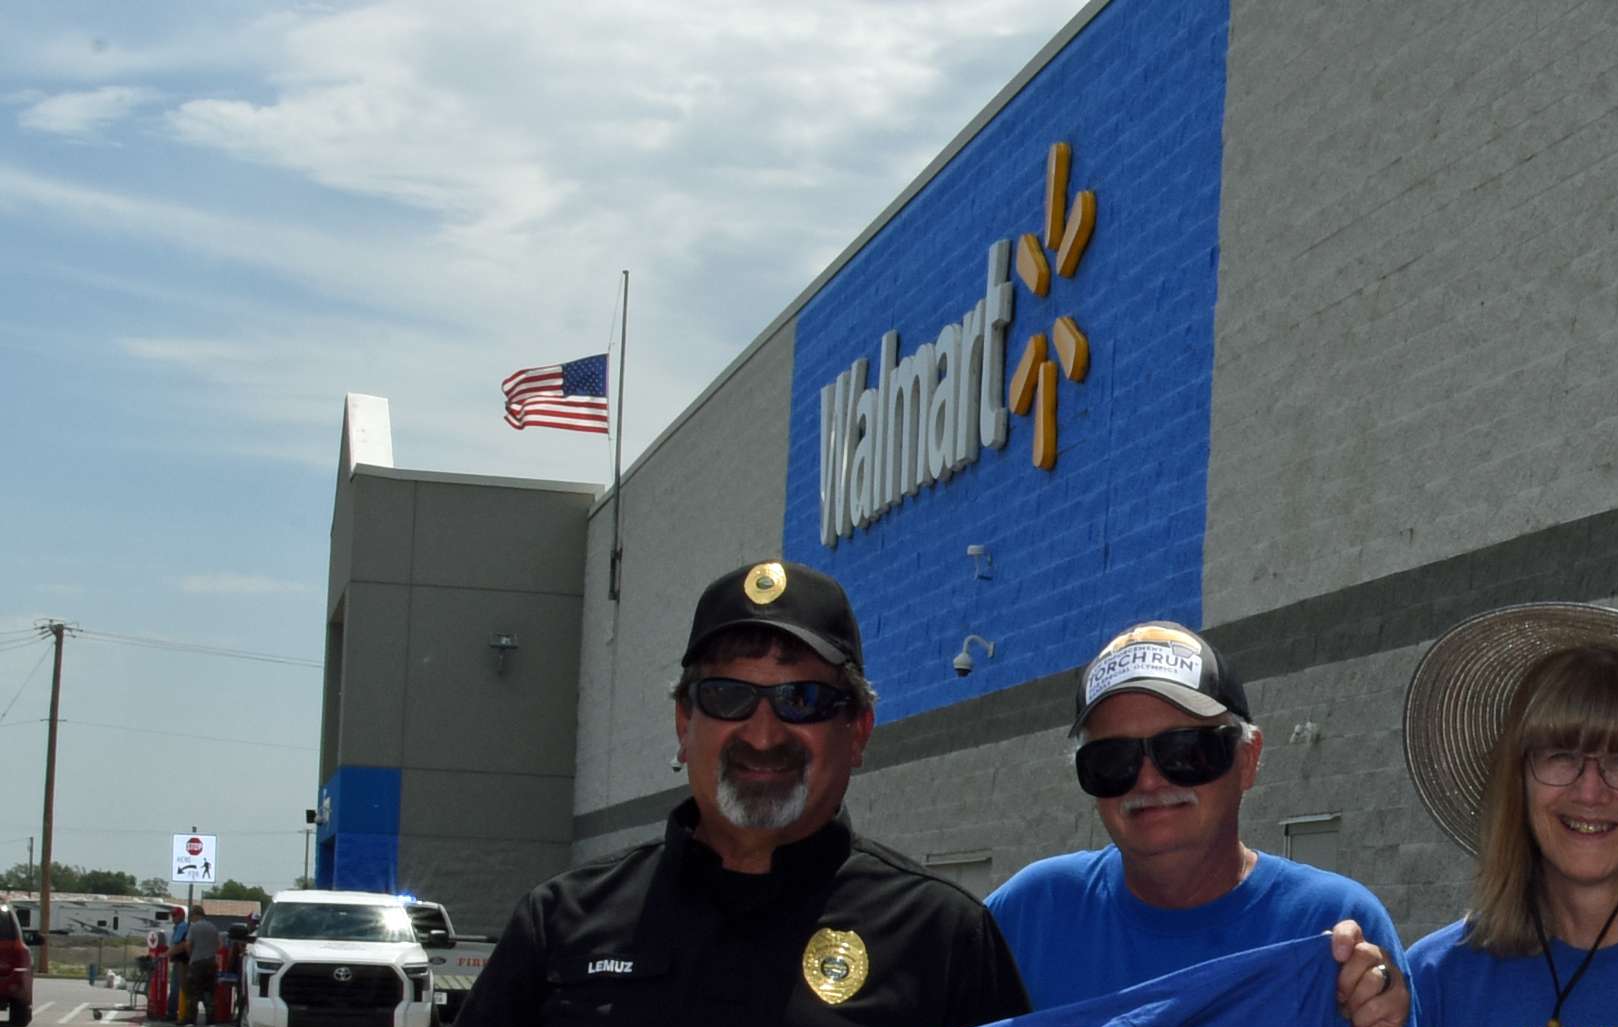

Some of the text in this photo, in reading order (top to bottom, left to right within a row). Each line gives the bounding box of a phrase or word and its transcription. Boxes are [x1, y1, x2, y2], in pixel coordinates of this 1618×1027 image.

[820, 239, 1013, 547] Walmart
[1090, 652, 1147, 687] TORCH
[588, 959, 633, 974] LEMUZ
